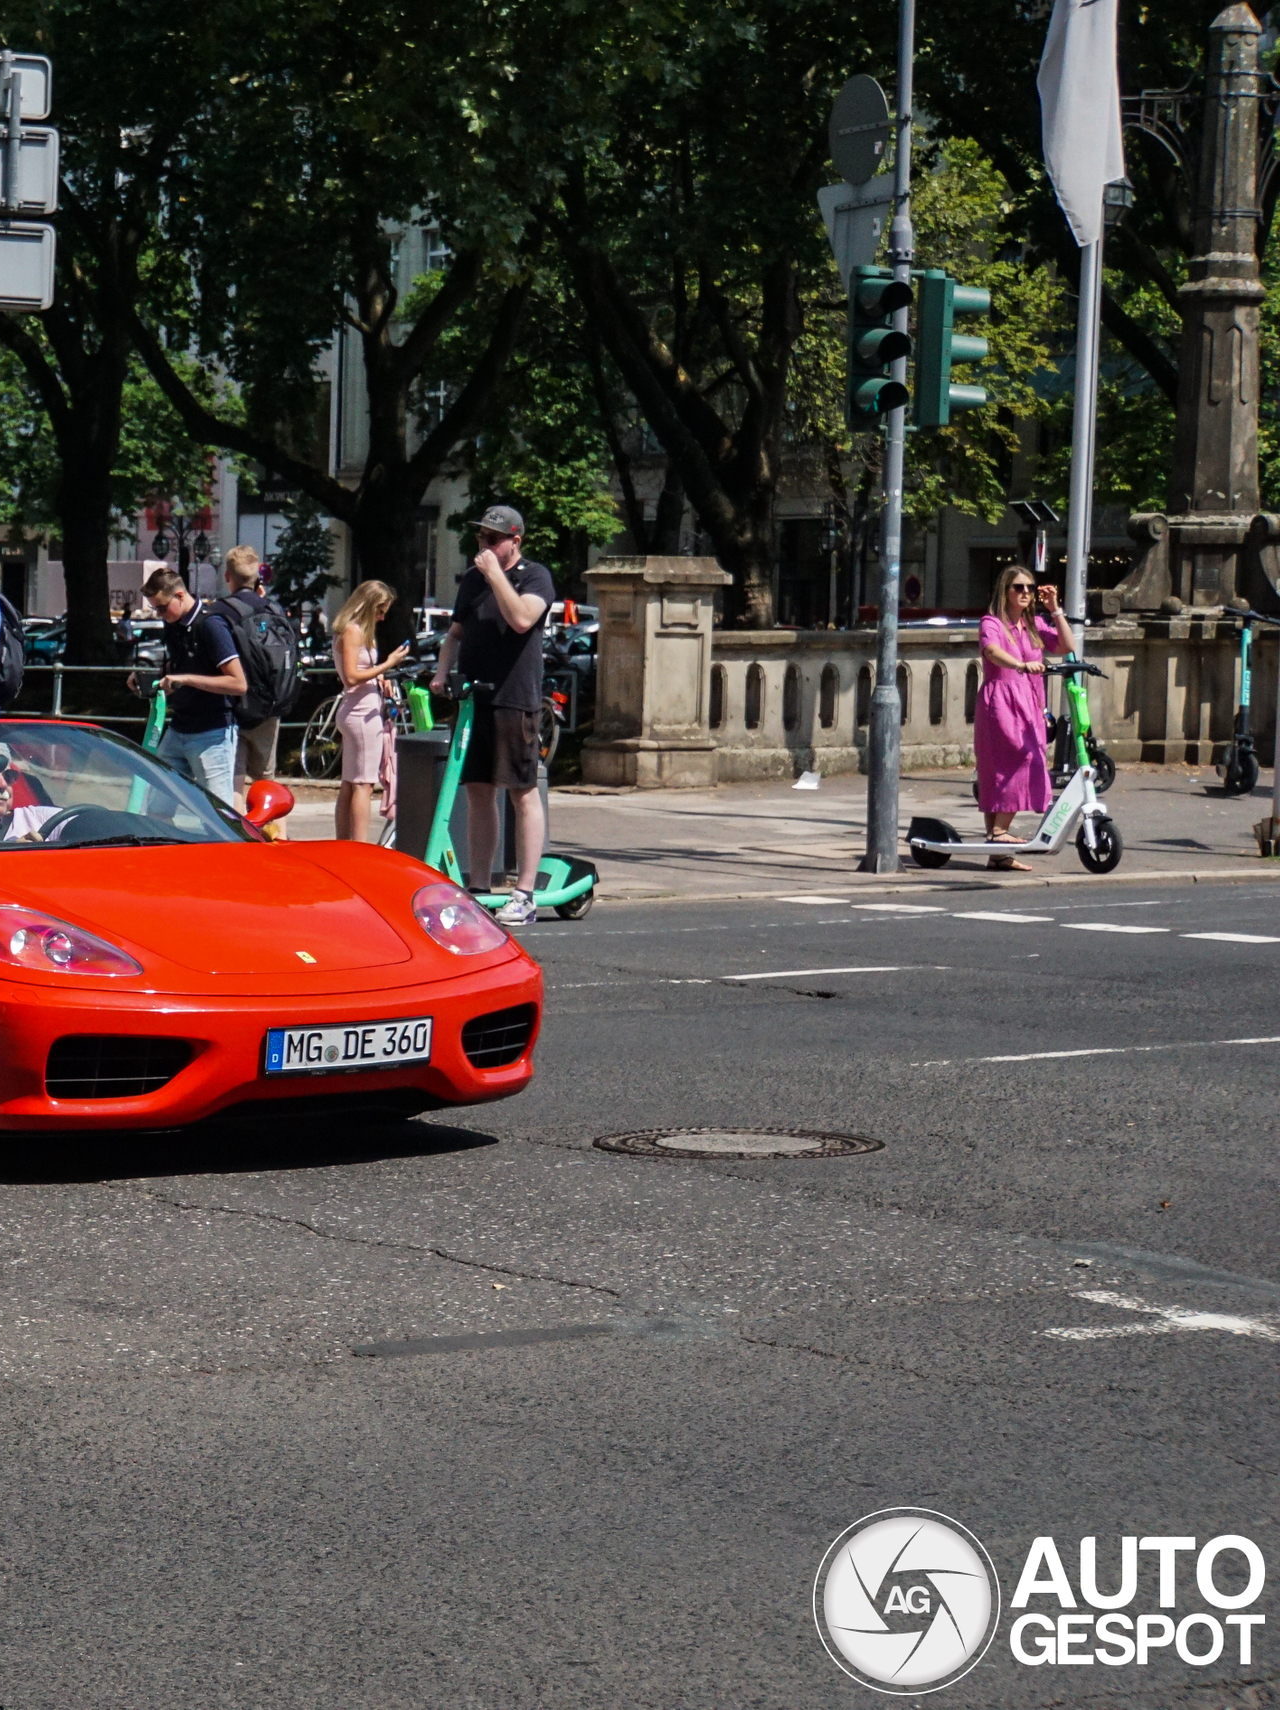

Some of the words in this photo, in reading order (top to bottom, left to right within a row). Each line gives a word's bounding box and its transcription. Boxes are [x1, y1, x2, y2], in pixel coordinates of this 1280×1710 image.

[286, 1032, 323, 1064] MG
[342, 1028, 376, 1060] DE
[382, 1023, 428, 1056] 360
[271, 1053, 279, 1063] D
